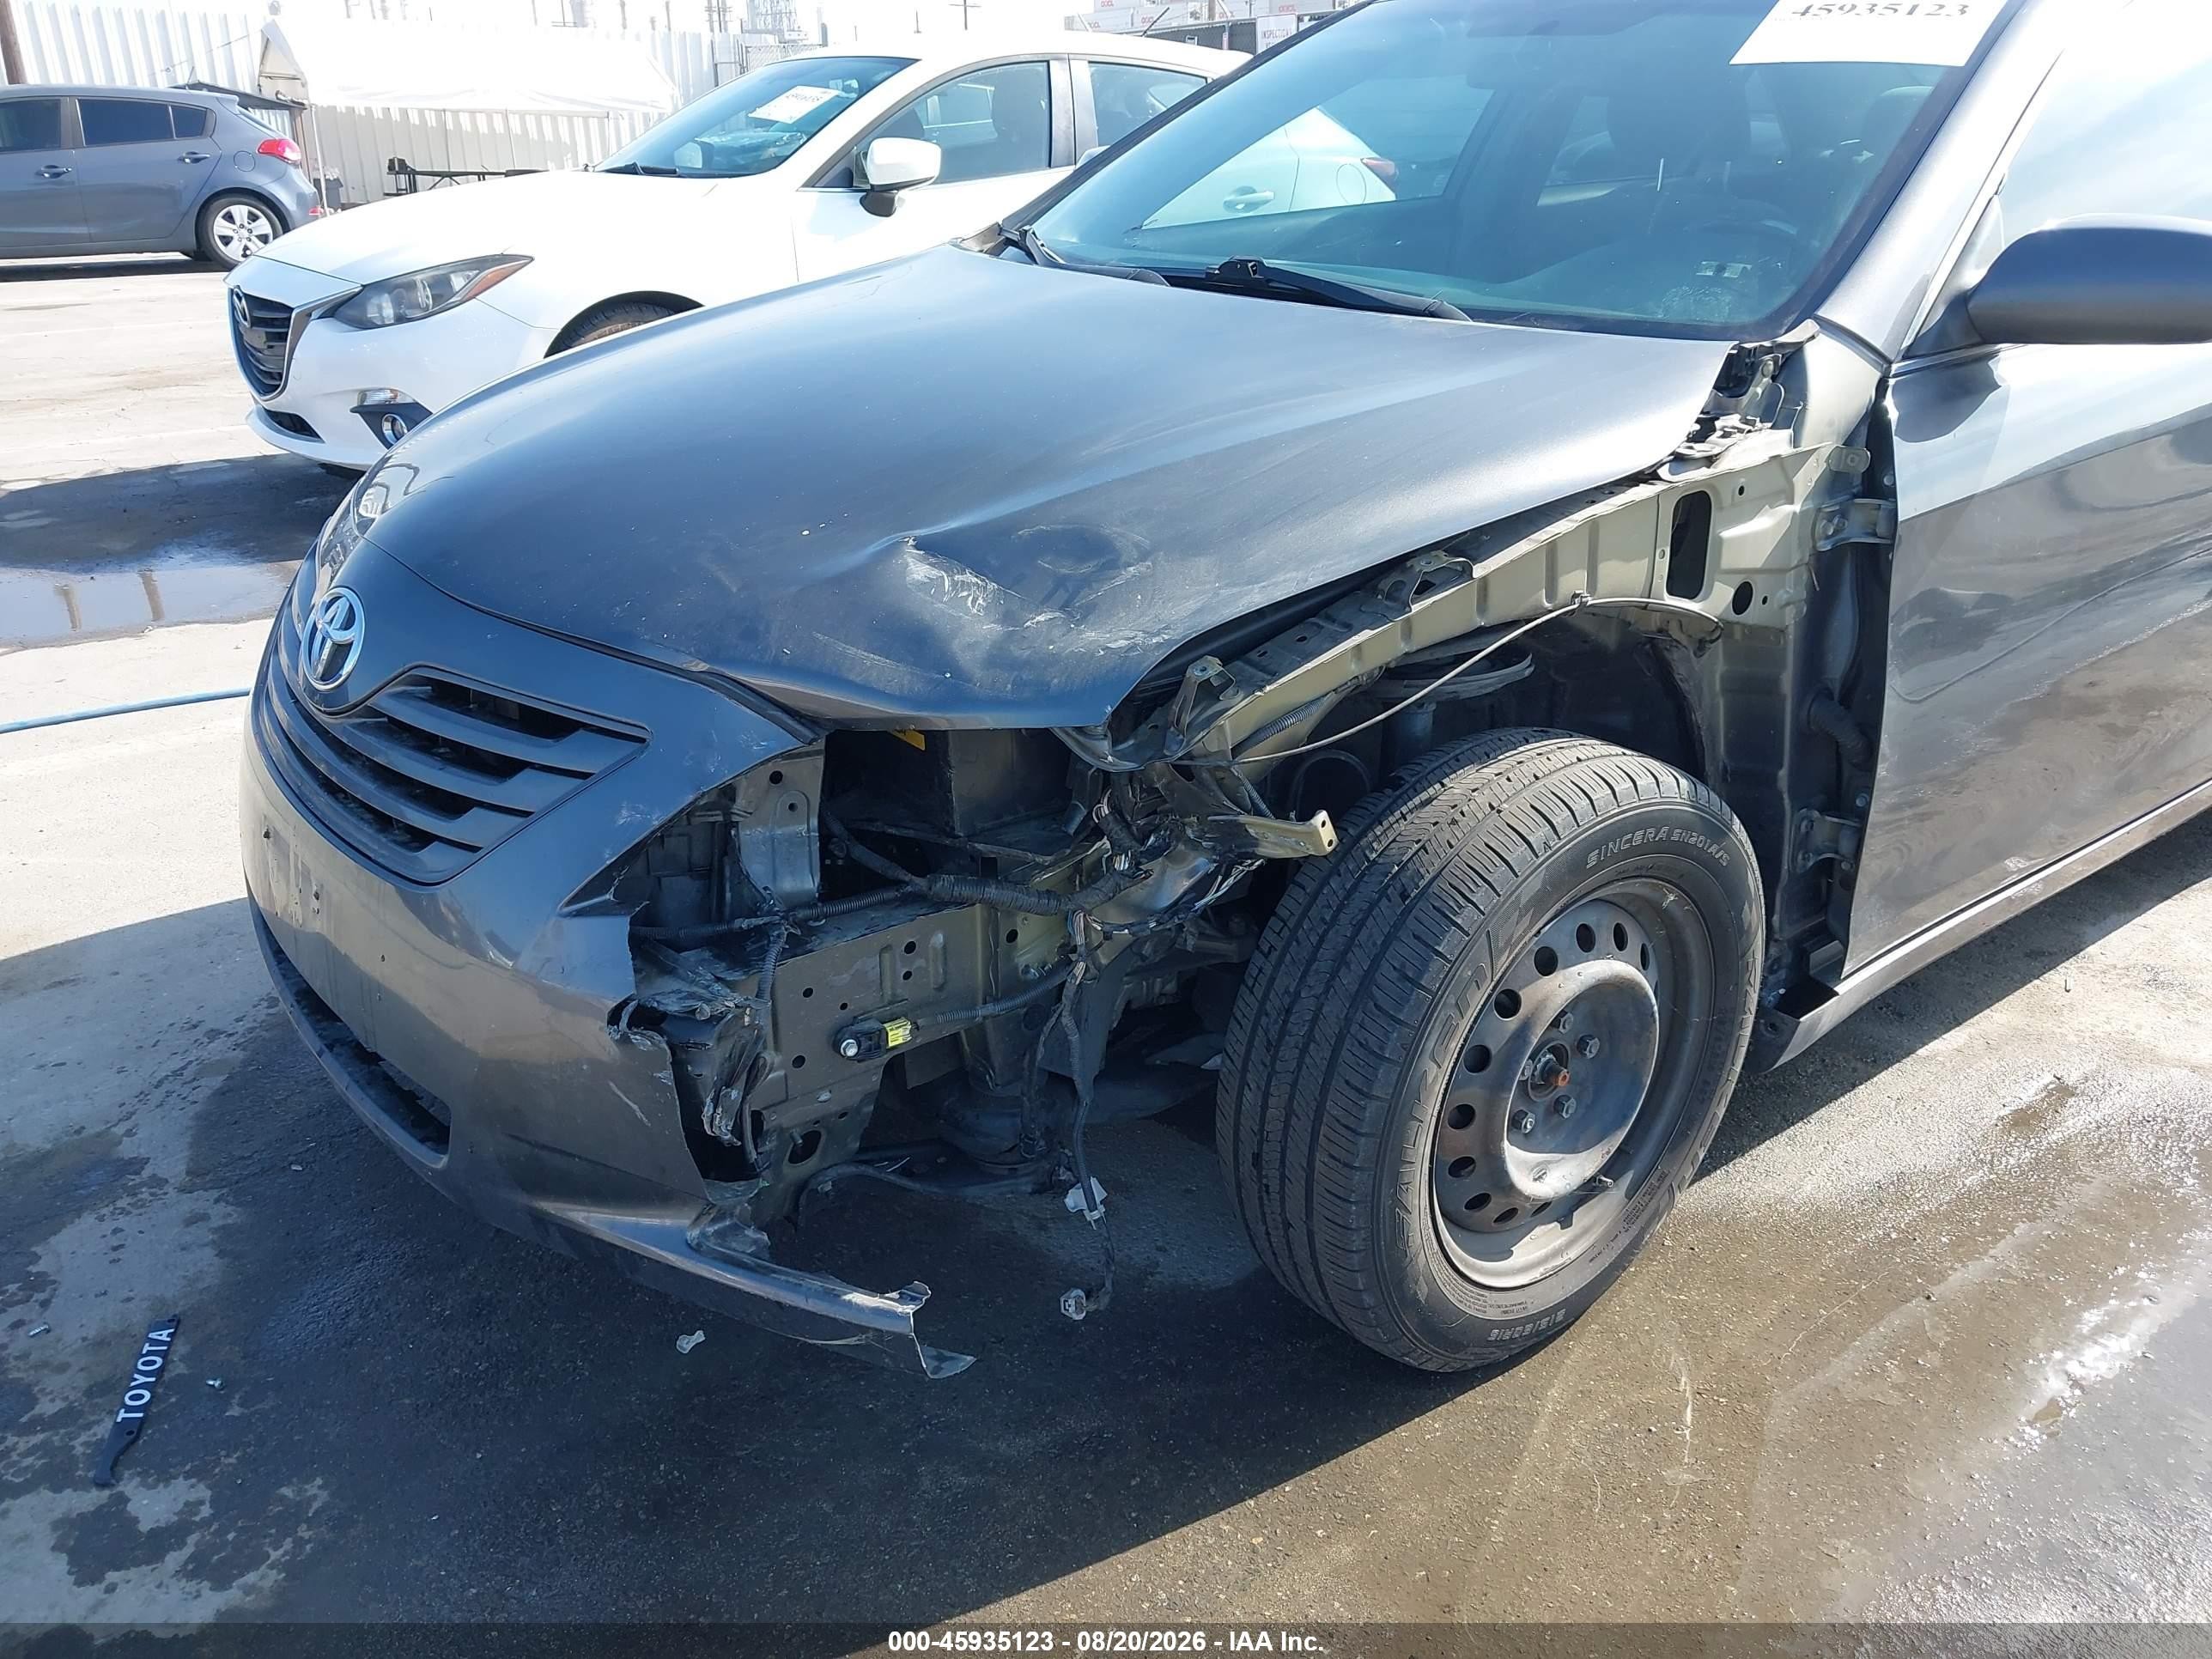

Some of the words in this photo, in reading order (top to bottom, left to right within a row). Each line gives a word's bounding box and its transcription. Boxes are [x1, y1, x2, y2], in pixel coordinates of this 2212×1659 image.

[1792, 3, 1970, 17] 45935123
[1586, 826, 1670, 869] SINCERA
[116, 1328, 175, 1423] TOYOTA
